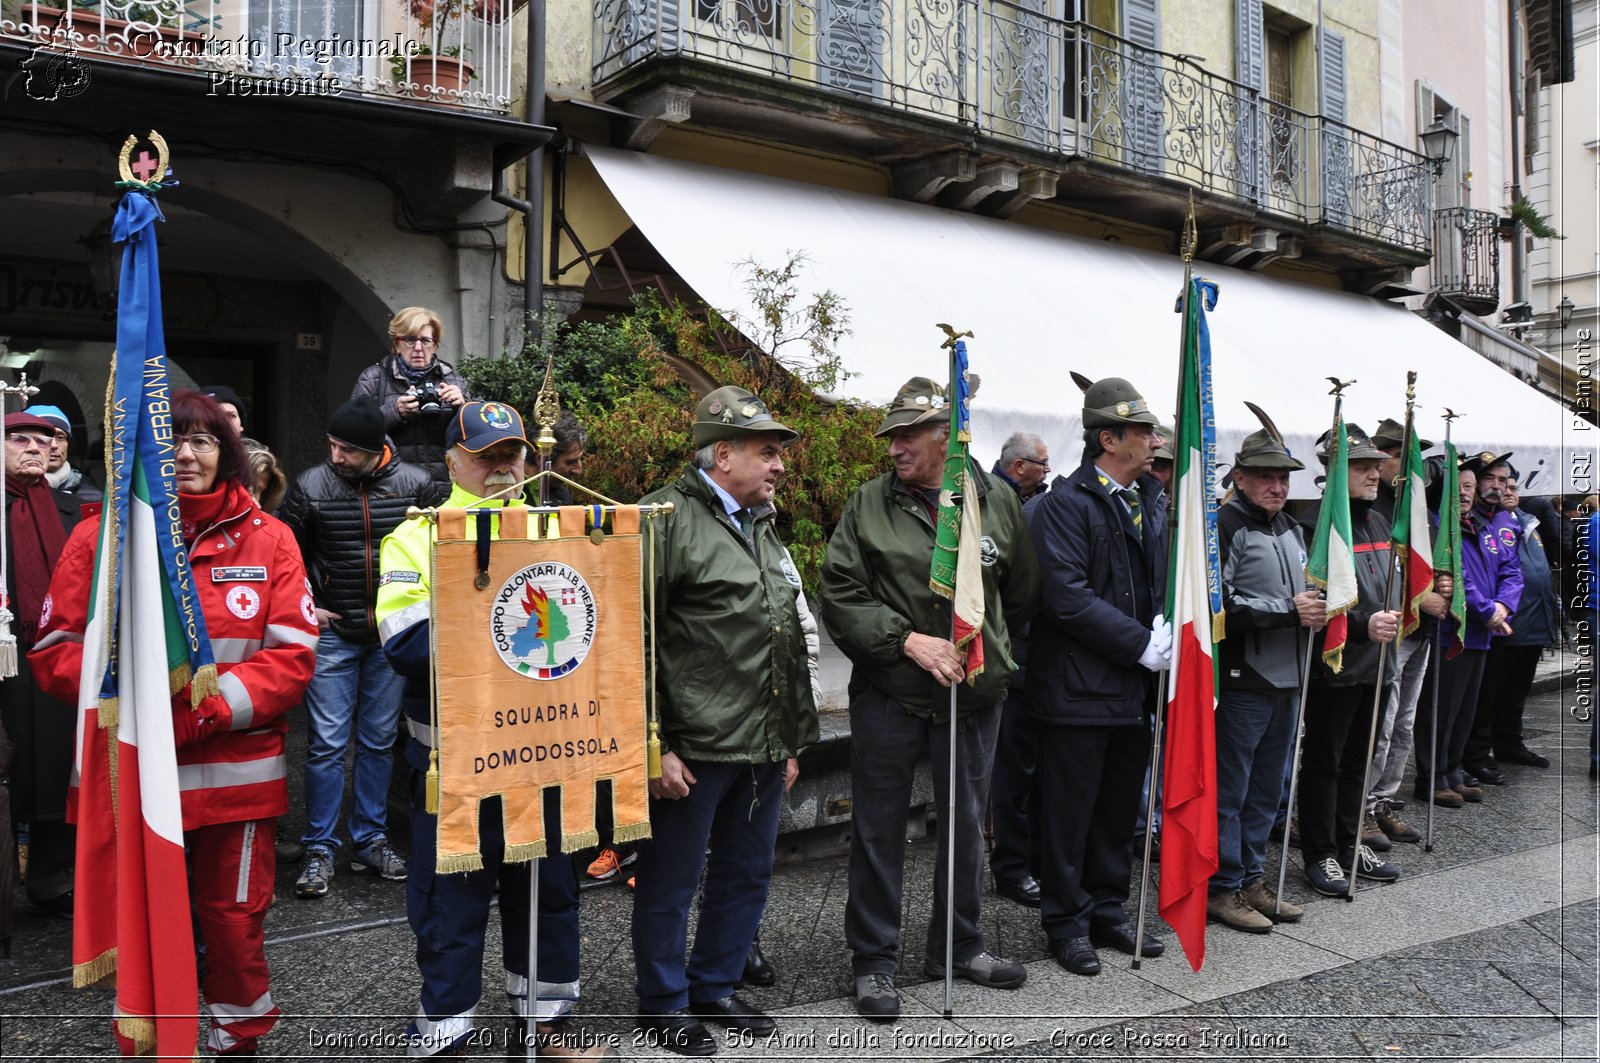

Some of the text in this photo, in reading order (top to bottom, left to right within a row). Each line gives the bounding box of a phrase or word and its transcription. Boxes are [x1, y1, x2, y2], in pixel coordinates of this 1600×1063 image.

[303, 336, 315, 346] 39
[143, 354, 175, 455] VERBANIA
[159, 459, 176, 477] DI
[1206, 442, 1217, 513] FINANZIERI
[175, 551, 199, 652] COMITATO
[493, 565, 595, 652] CORPO VOLONTARI A.I.B. PIEMONTE
[494, 700, 601, 728] SQUADRA DI
[474, 737, 619, 774] DOMODOSSOLA
